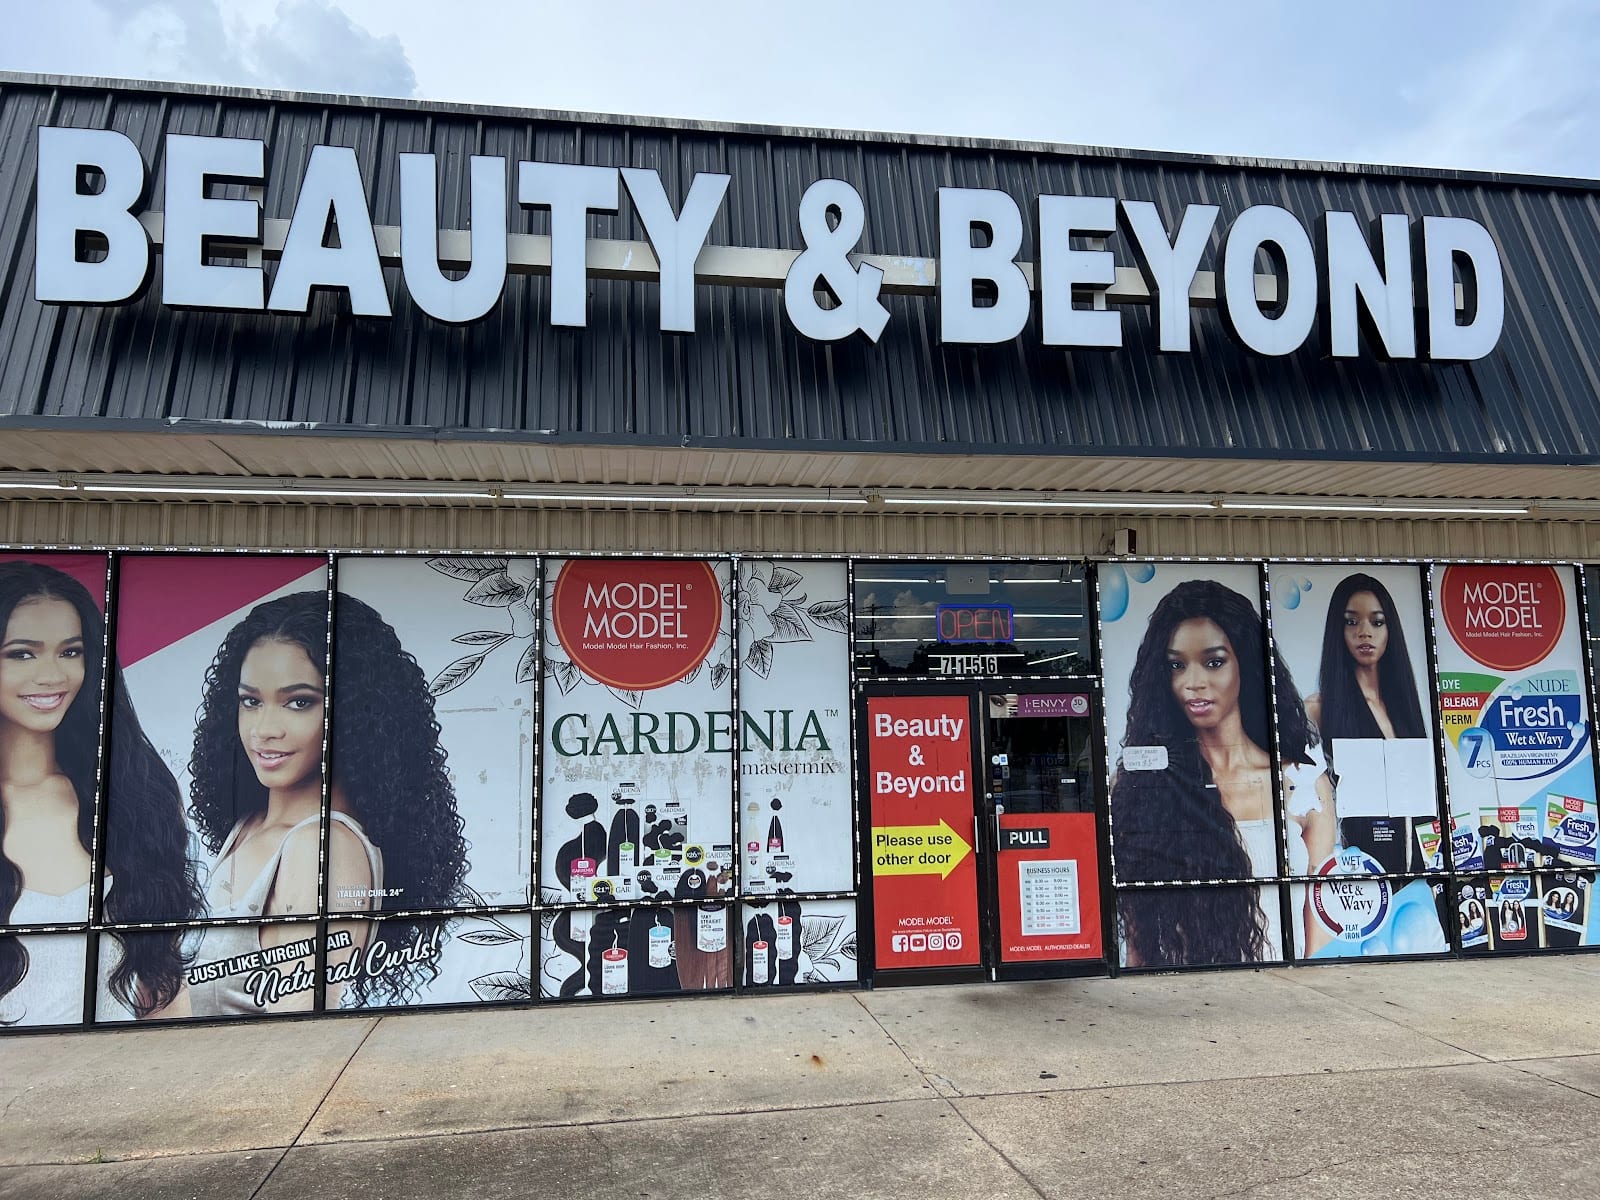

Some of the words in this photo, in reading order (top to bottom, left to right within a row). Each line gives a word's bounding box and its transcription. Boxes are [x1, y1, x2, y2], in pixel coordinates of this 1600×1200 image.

[35, 126, 731, 332] BEAUTY
[784, 178, 892, 344] &
[938, 186, 1505, 361] BEYOND
[1465, 606, 1542, 628] MODEL
[583, 612, 688, 639] MODEL
[940, 609, 1011, 640] OPEN
[583, 642, 605, 650] Model
[607, 642, 628, 650] Model
[629, 642, 644, 650] Hair
[646, 642, 675, 651] Fashion,
[676, 641, 689, 650] Inc.
[941, 657, 998, 675] 7156
[1442, 679, 1461, 690] DYE
[1527, 679, 1570, 693] NUDE
[1444, 697, 1479, 708] BLEACH
[1445, 714, 1472, 725] PERM
[1500, 698, 1565, 728] Fresh
[874, 713, 964, 741] Beauty
[1505, 732, 1528, 746] Wet
[1528, 734, 1537, 745] &
[1535, 732, 1564, 748] Wavy
[908, 744, 925, 766] &
[1462, 735, 1484, 769] 7
[1476, 760, 1491, 768] PCS
[742, 757, 837, 775] mastermix
[876, 770, 965, 798] Beyond
[1516, 822, 1535, 831] Fresh
[1567, 819, 1589, 832] Fresh
[876, 834, 922, 847] Please
[927, 835, 952, 845] use
[1009, 831, 1048, 845] PULL
[877, 853, 915, 866] other
[918, 852, 951, 865] door
[1341, 855, 1361, 866] WET
[1434, 855, 1440, 867] 7
[1328, 881, 1353, 895] Wet
[1354, 885, 1364, 896] &
[1505, 880, 1525, 889] Fresh
[336, 889, 366, 898] ITALIAN
[368, 889, 388, 898] CURL
[1339, 895, 1374, 915] Wavy
[898, 917, 925, 927] MODEL
[1345, 932, 1360, 940] IRON
[366, 925, 440, 977] Curls!
[190, 967, 226, 984] JUST
[228, 954, 261, 975] LIKE
[261, 939, 311, 965] VIRGIN
